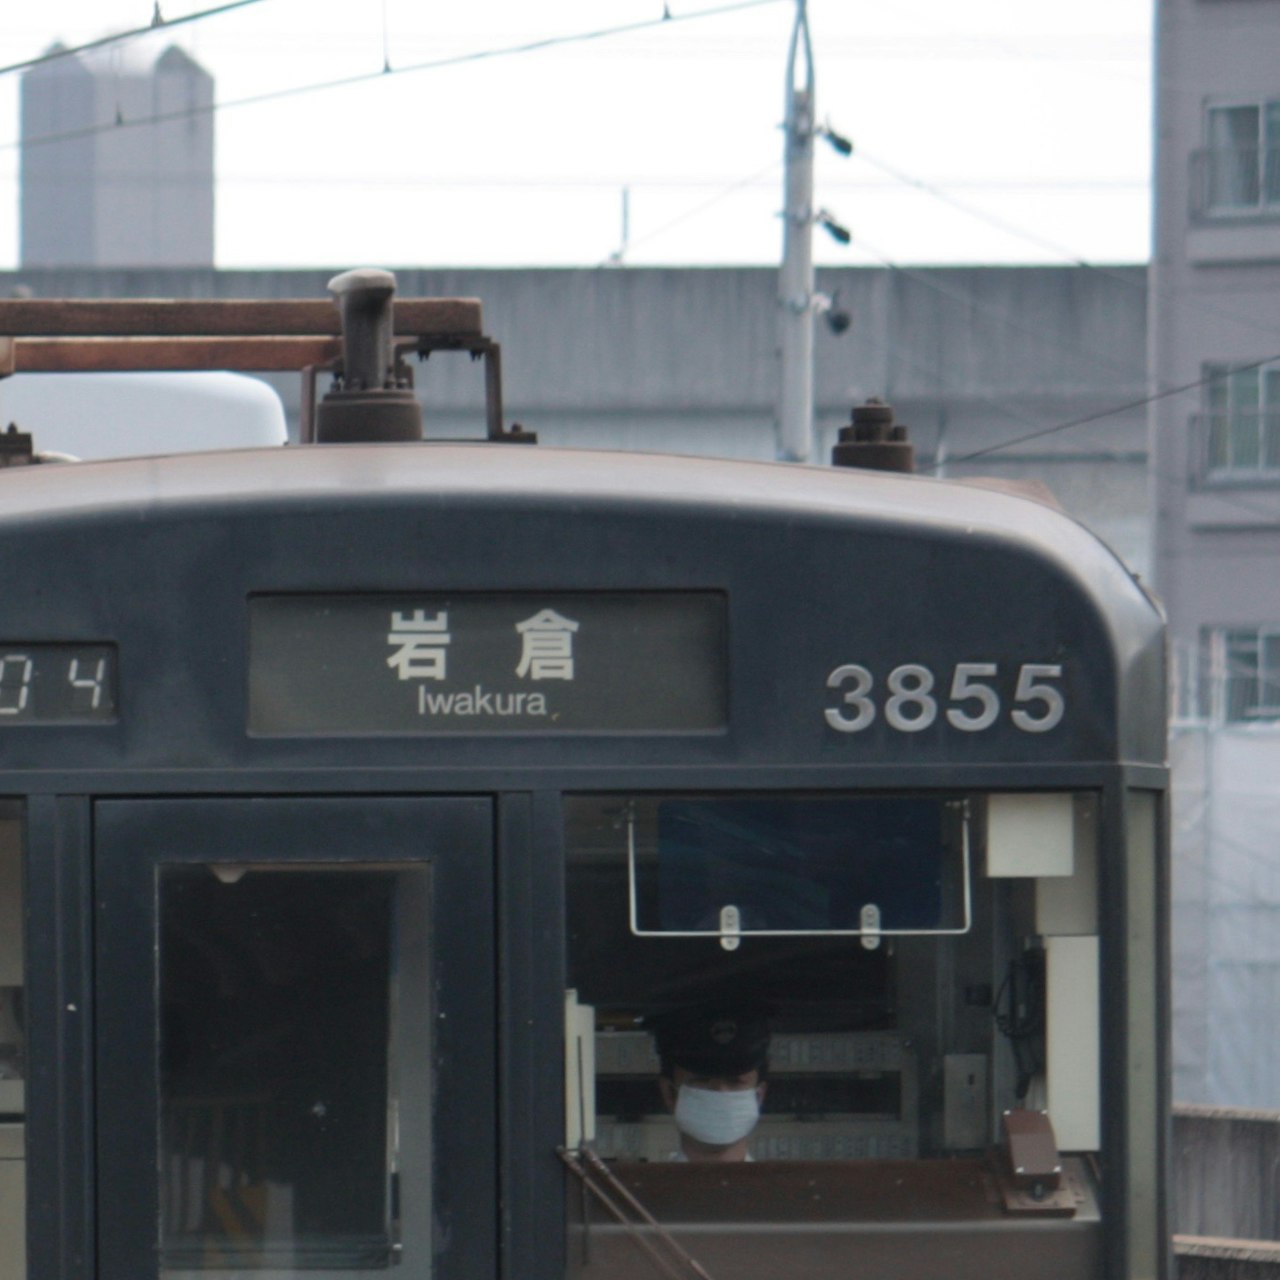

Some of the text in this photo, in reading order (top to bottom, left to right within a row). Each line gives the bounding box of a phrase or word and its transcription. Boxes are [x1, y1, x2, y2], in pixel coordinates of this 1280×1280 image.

[385, 609, 580, 681] 岩倉
[417, 685, 549, 716] Iwakura
[824, 662, 1066, 734] 3855
